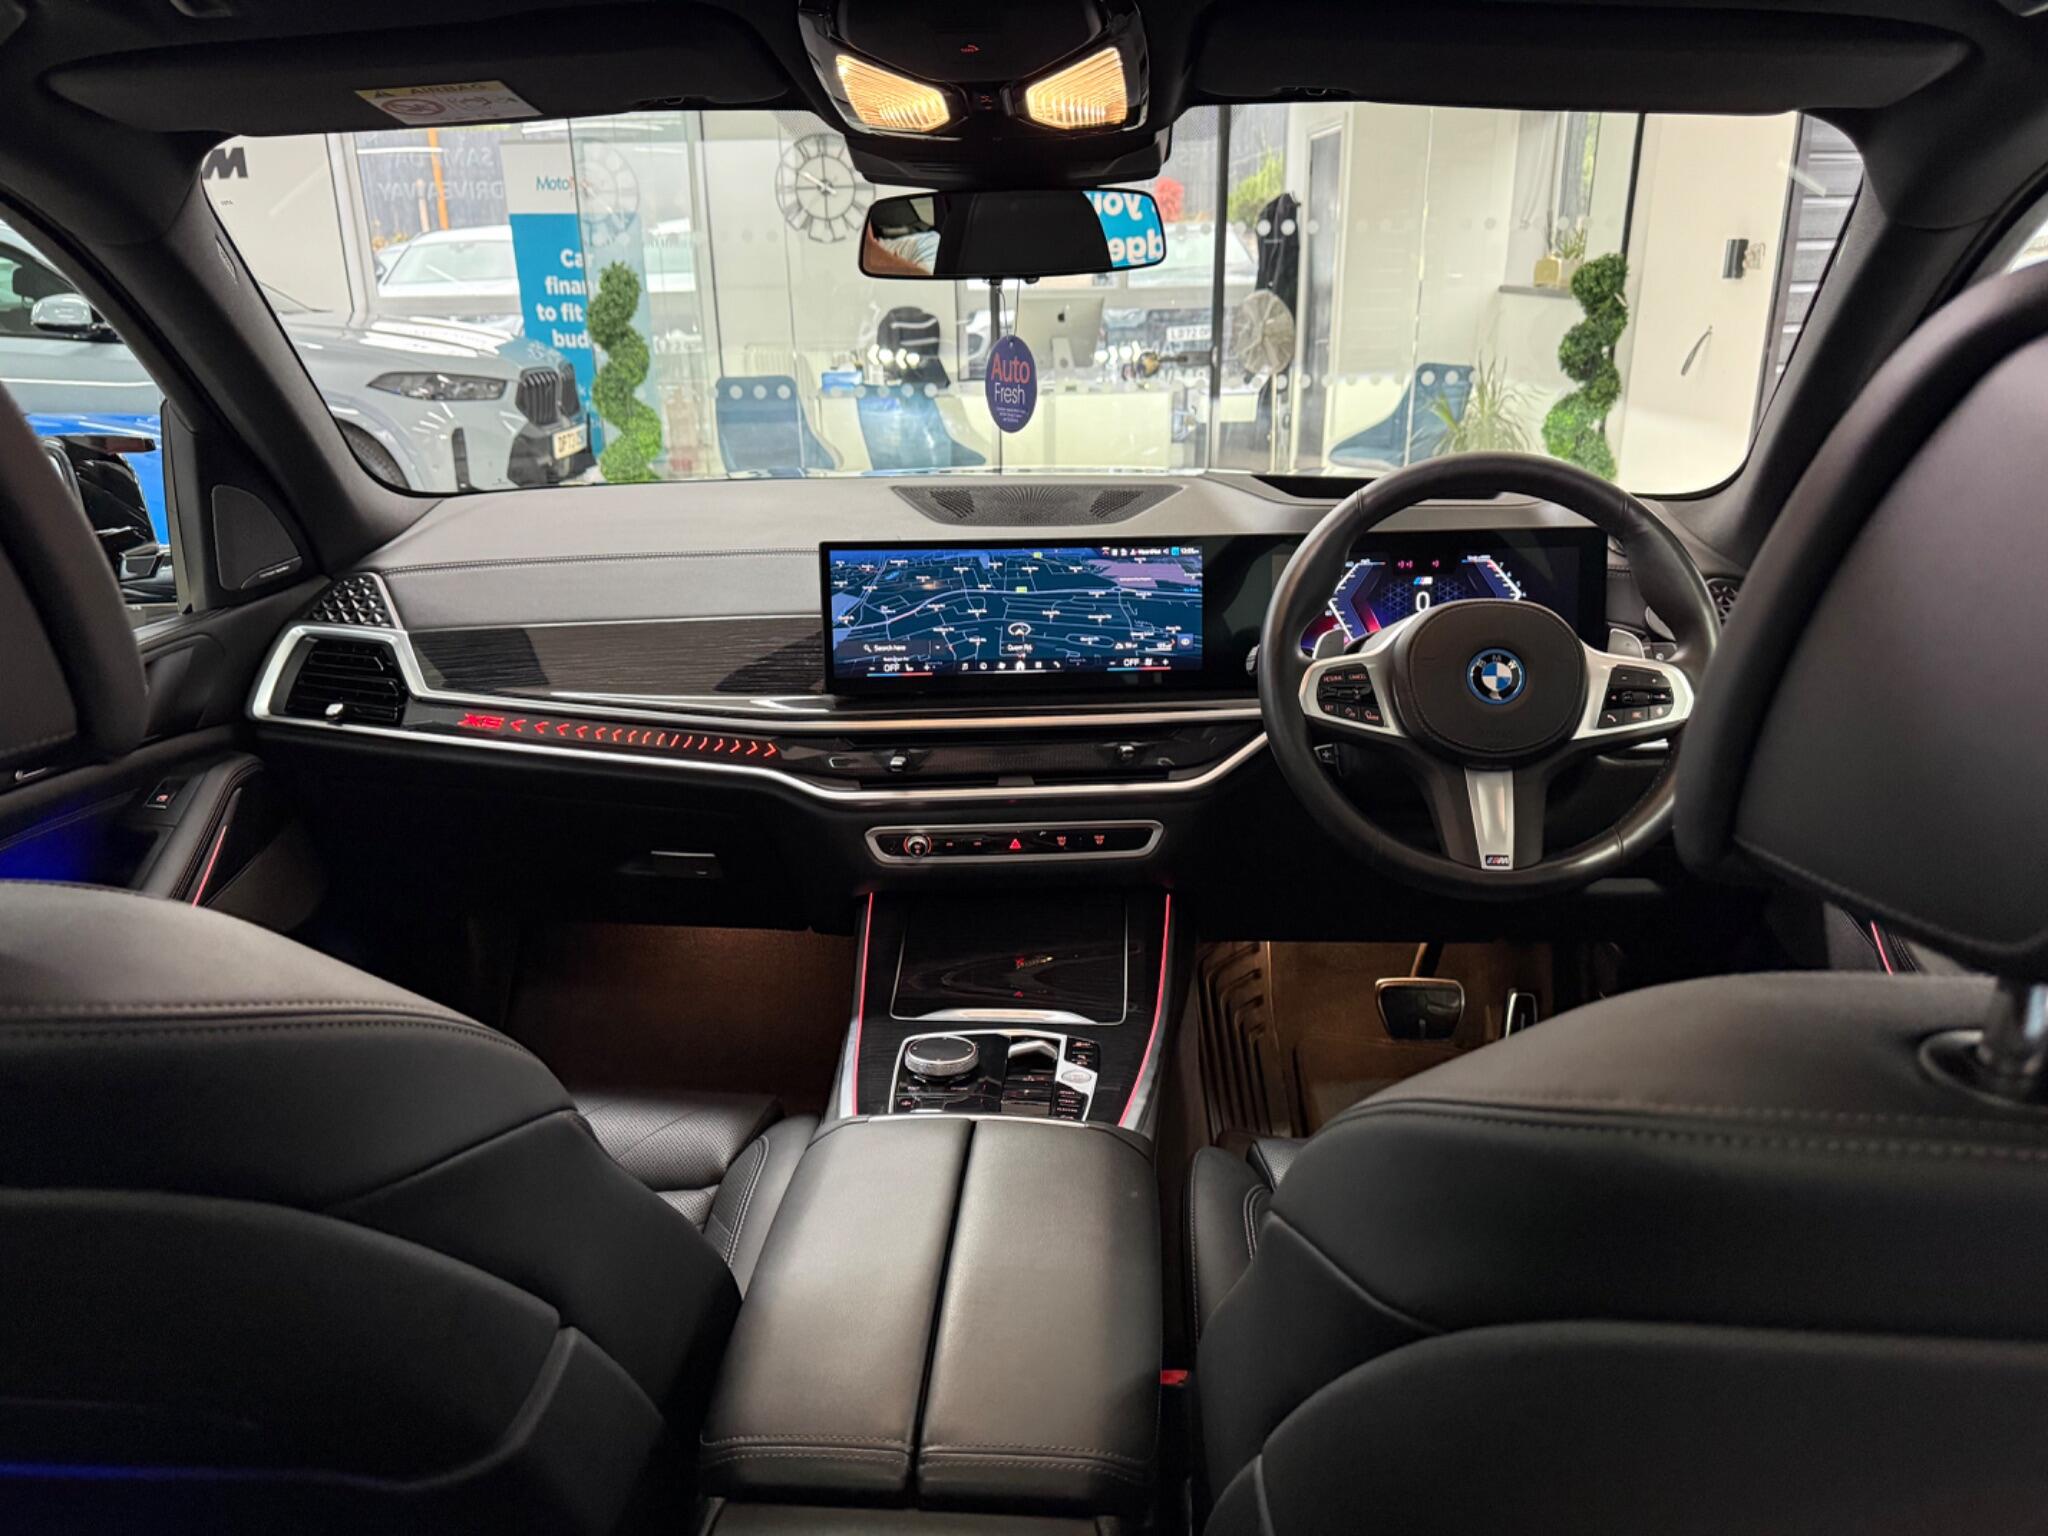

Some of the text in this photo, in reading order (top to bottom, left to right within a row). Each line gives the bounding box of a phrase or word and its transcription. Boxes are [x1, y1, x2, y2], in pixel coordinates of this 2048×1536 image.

[410, 82, 487, 95] AIRBAG
[560, 248, 594, 268] Car
[535, 302, 584, 322] to fit
[552, 328, 596, 349] bud
[991, 352, 1031, 384] Auto
[994, 382, 1025, 405] Fresh
